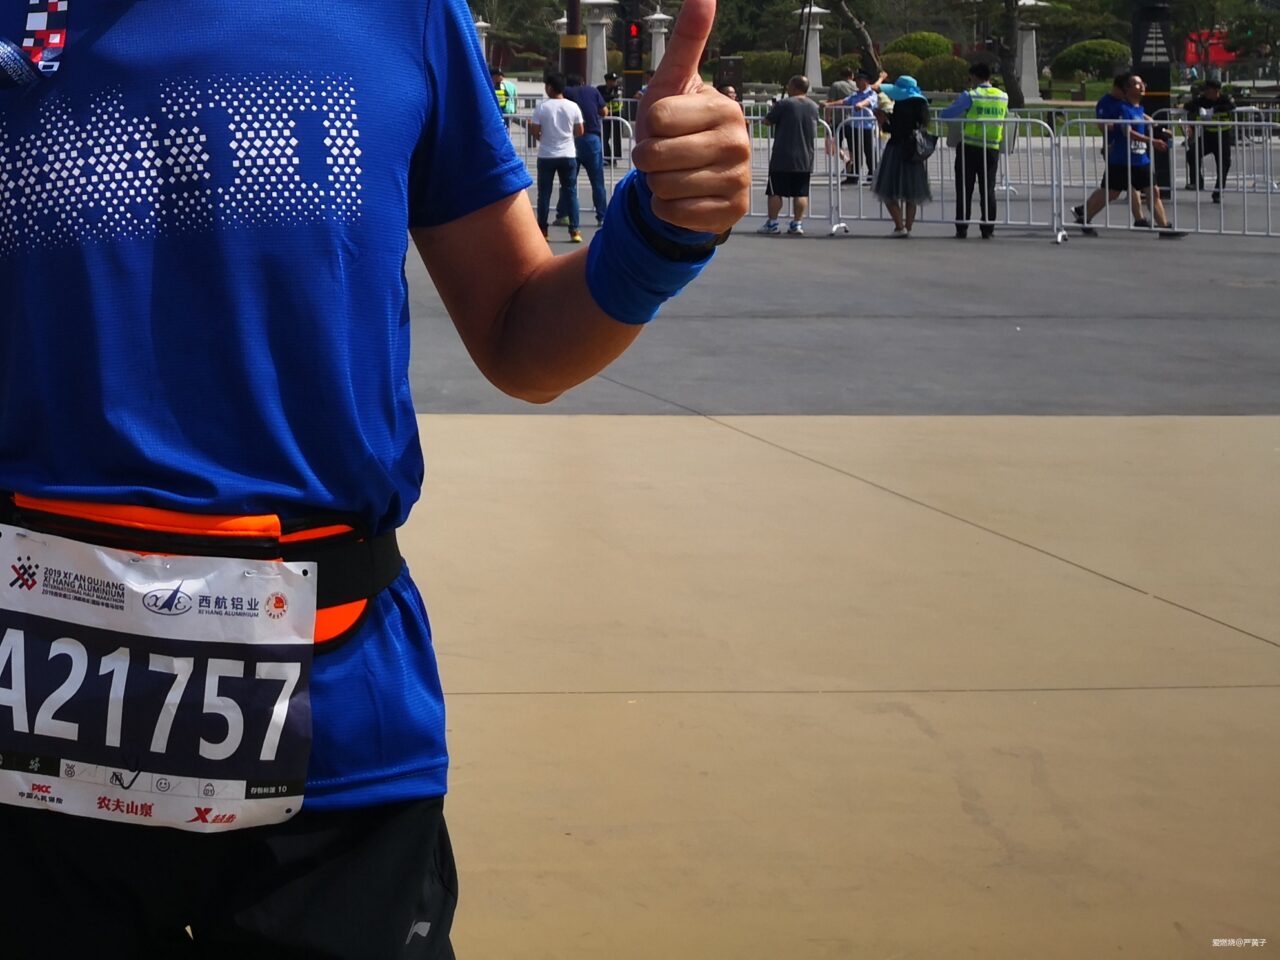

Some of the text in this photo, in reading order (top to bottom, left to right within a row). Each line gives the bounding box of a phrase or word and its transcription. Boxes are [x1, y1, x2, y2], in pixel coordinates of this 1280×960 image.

[43, 567, 61, 578] 2019
[78, 581, 125, 599] ALUMINIUM
[198, 594, 260, 611] 西航铝业
[31, 783, 52, 794] PICC
[18, 791, 64, 805] 中国人民保险
[96, 796, 154, 818] 农夫山泉
